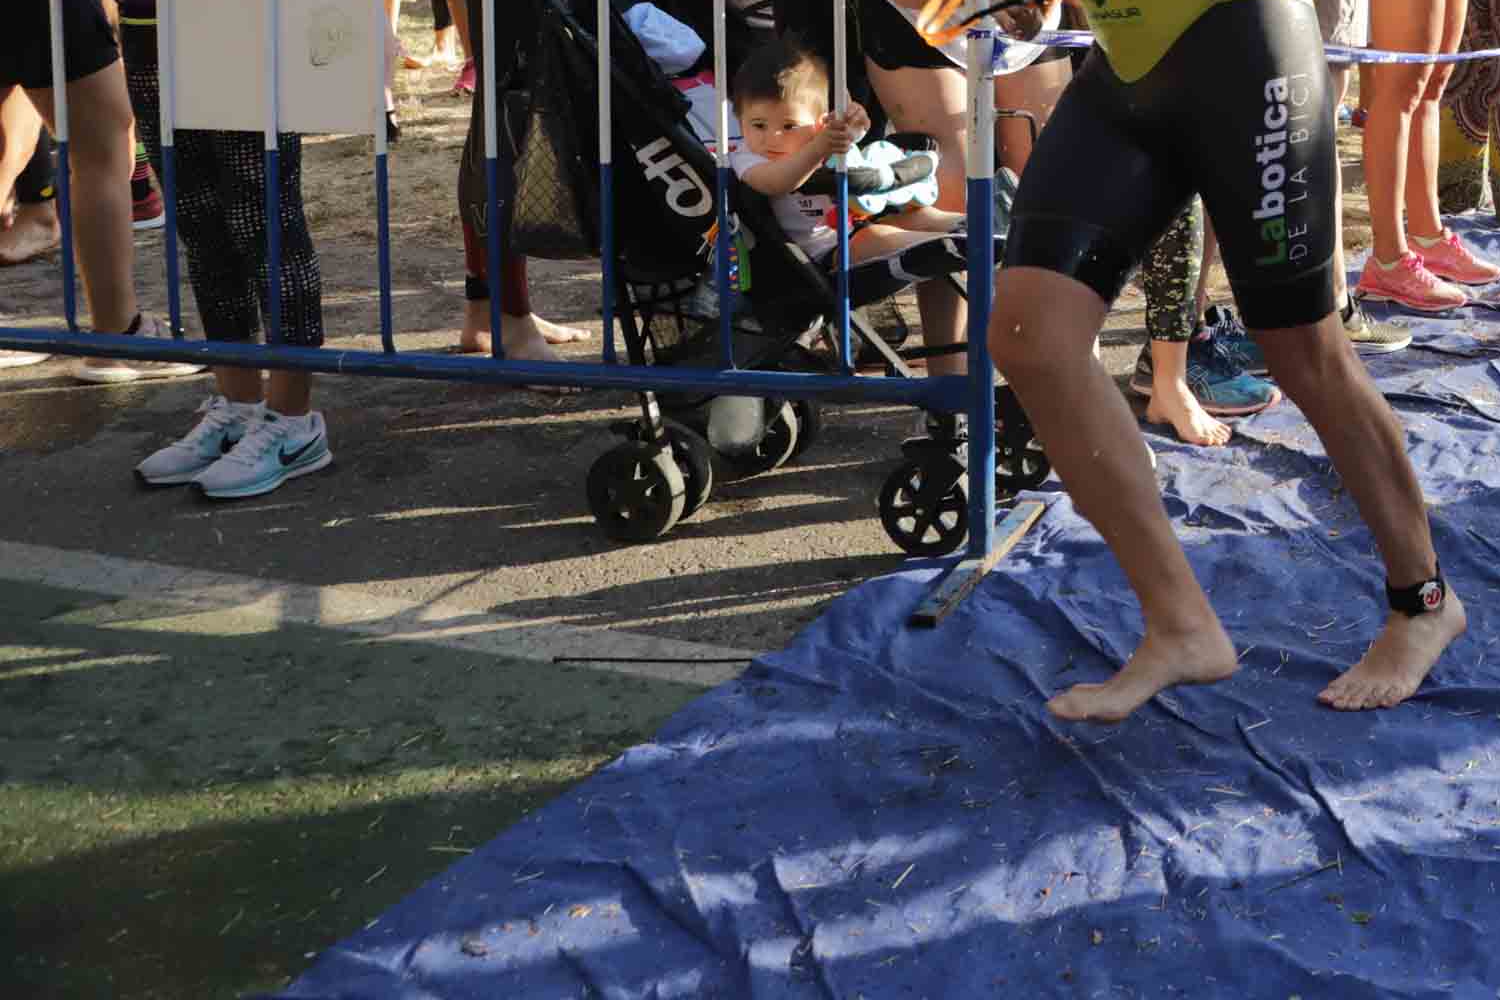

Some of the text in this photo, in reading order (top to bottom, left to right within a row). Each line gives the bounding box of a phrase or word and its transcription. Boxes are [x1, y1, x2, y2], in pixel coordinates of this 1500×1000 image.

[1288, 72, 1310, 264] DE LA BICI
